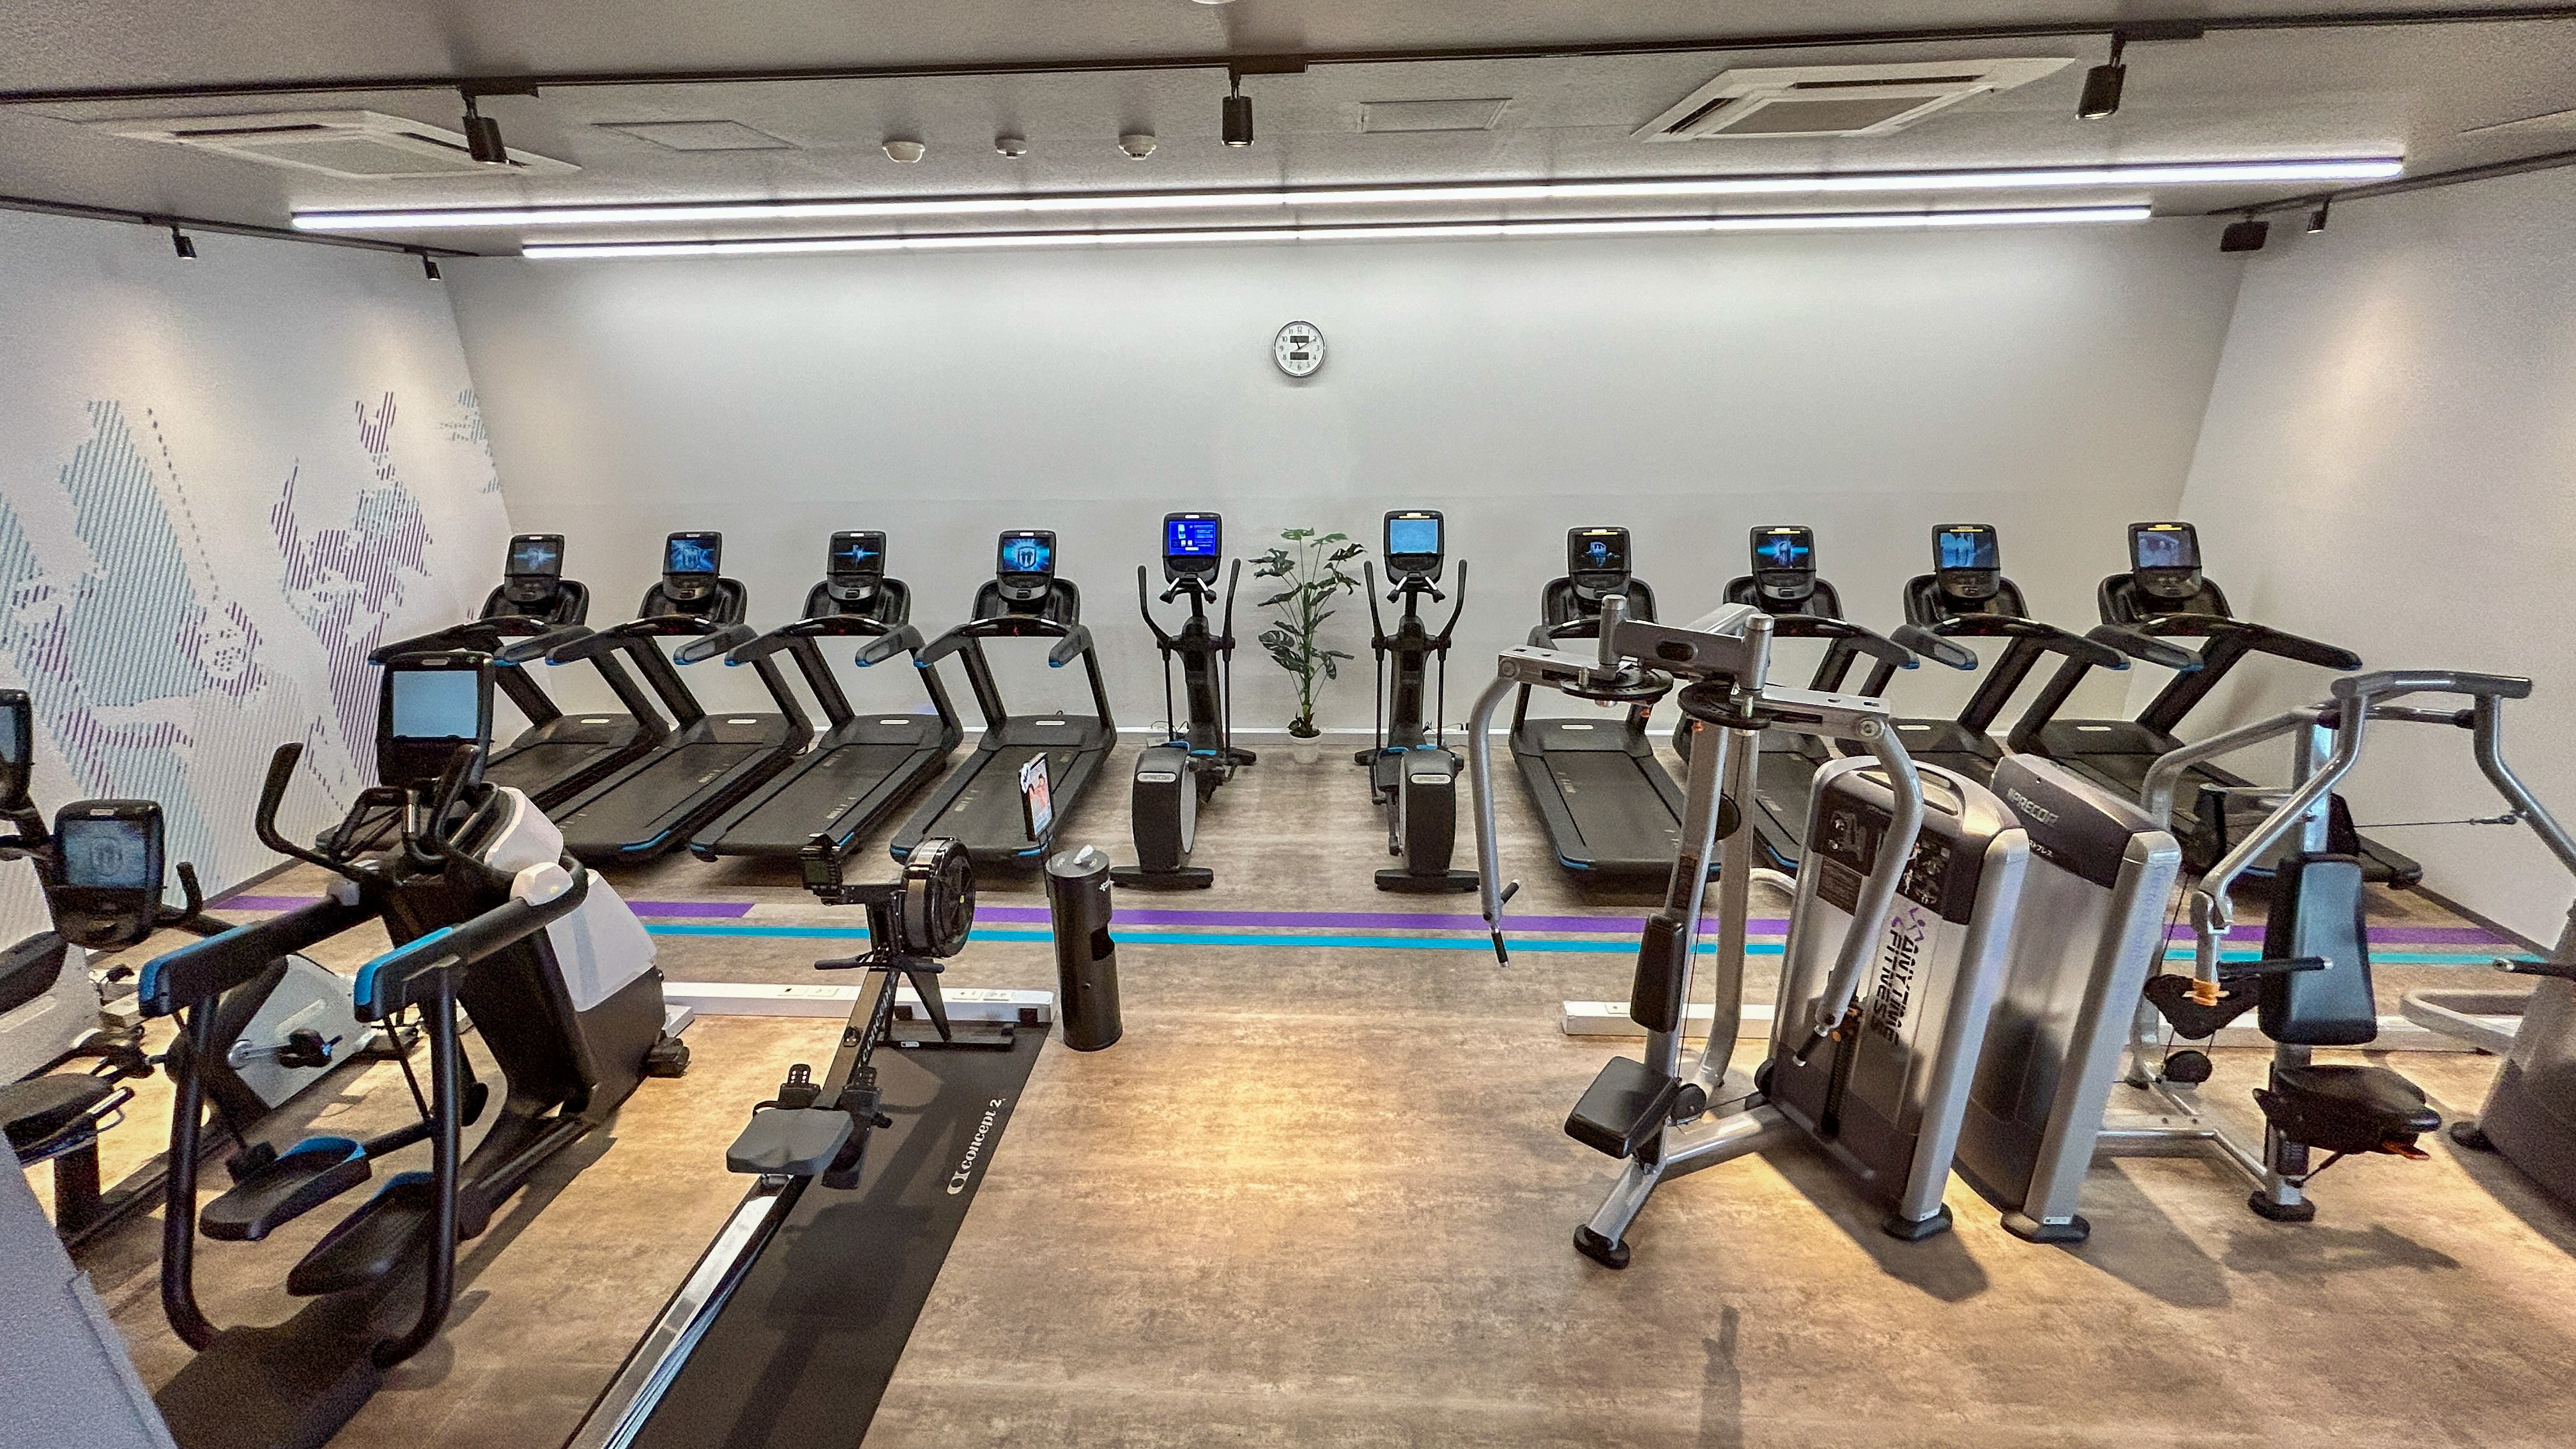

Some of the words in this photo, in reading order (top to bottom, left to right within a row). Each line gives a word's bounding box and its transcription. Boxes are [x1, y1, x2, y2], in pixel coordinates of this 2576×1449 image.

[2012, 790, 2058, 826] PRECOR
[1869, 928, 1903, 1033] FITNESS
[1884, 934, 1919, 1046] ANYTIME
[961, 1110, 997, 1170] concept
[990, 1098, 1002, 1108] 2
